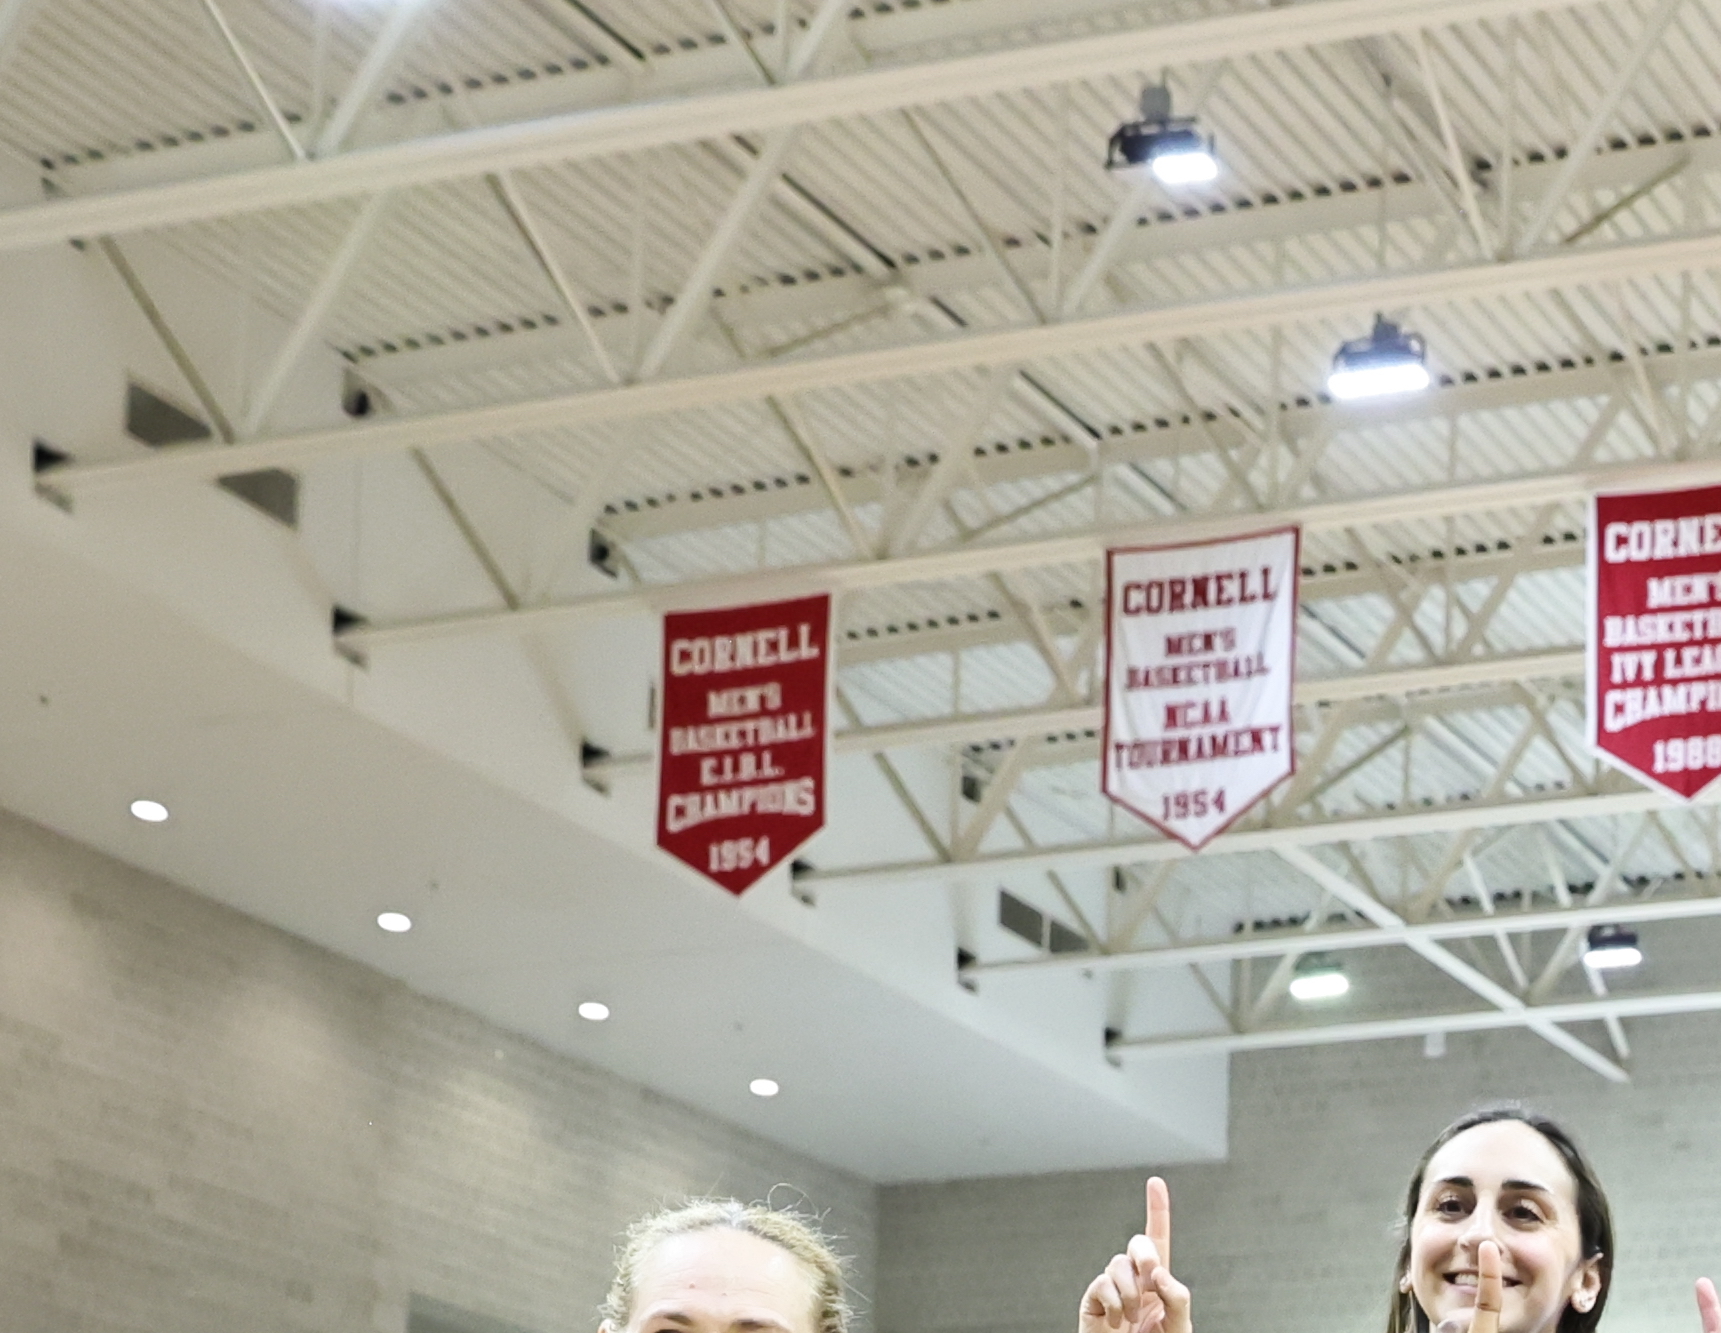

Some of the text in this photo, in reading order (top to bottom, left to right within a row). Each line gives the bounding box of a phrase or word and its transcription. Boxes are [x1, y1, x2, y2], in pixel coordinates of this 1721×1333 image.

[1122, 566, 1278, 617] CORNELL
[670, 623, 819, 676] CORNELL
[1164, 627, 1236, 659] MEN'S
[1127, 651, 1269, 692] BASKETBALL
[1610, 648, 1658, 685] IVY
[707, 681, 781, 718] MEN'S
[1164, 700, 1230, 730] NCAA
[669, 709, 816, 756] BASKETBALL
[1114, 726, 1281, 772] TOURNAMENT
[666, 779, 816, 834] CHAMPIONS
[1161, 789, 1226, 822] 1954
